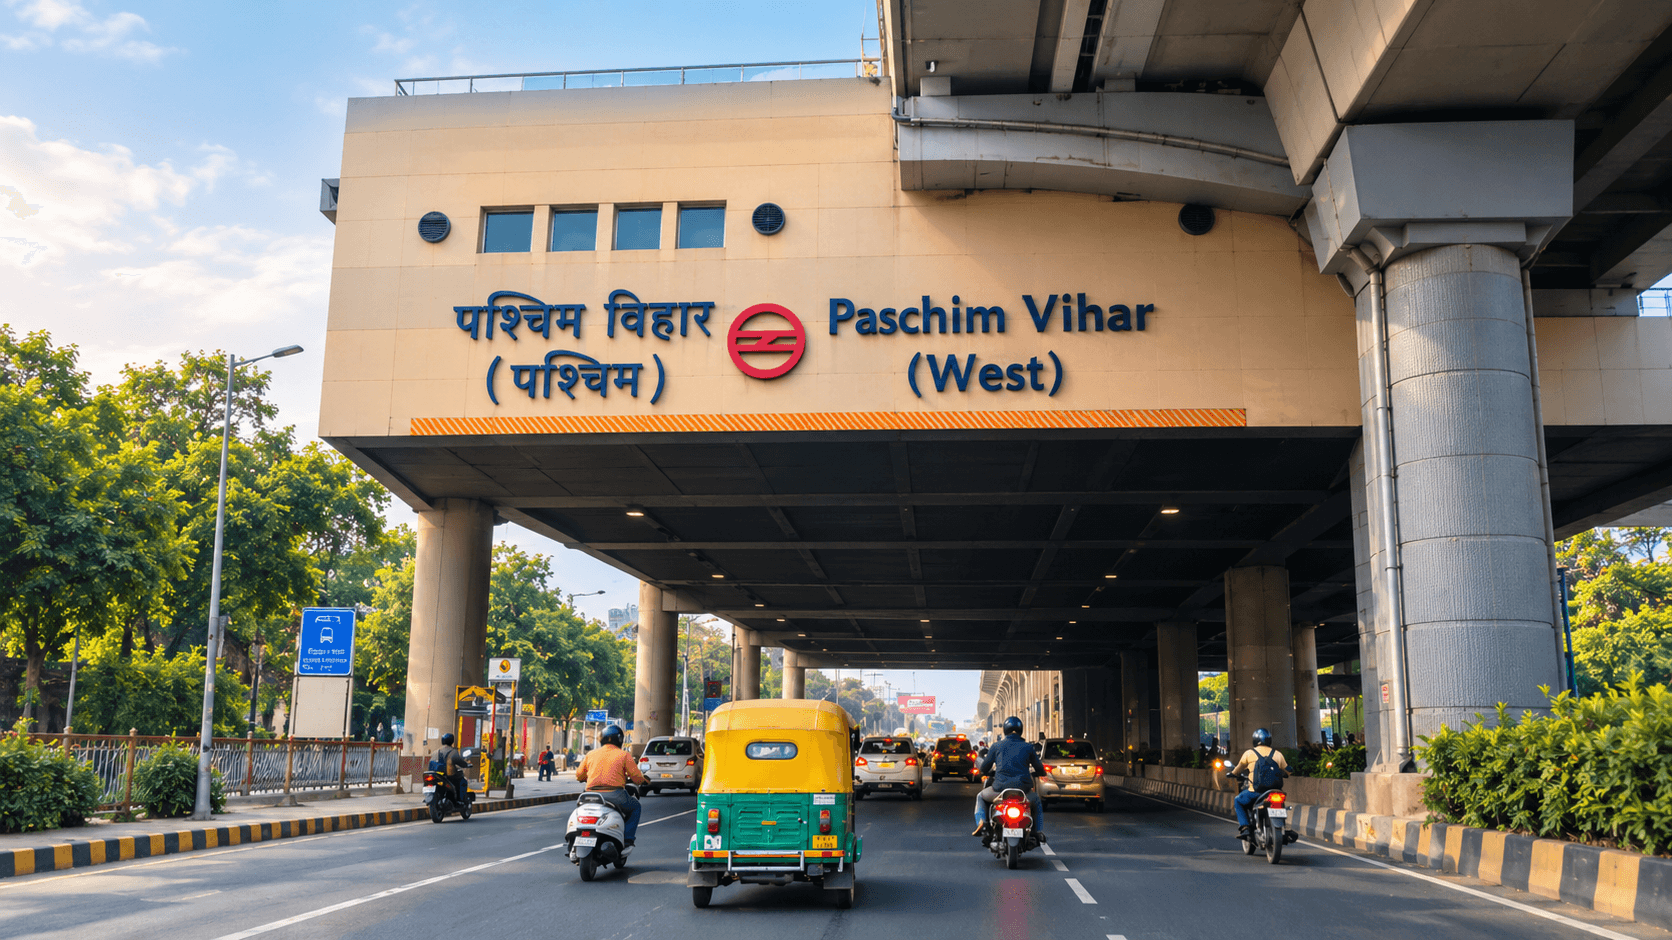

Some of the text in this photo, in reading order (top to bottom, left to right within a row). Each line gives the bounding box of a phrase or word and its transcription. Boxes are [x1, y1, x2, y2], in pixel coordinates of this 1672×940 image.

[453, 289, 716, 341] पश्चिम विहार
[829, 293, 1155, 336] Paschim Vihar
[908, 351, 1064, 398] (West)
